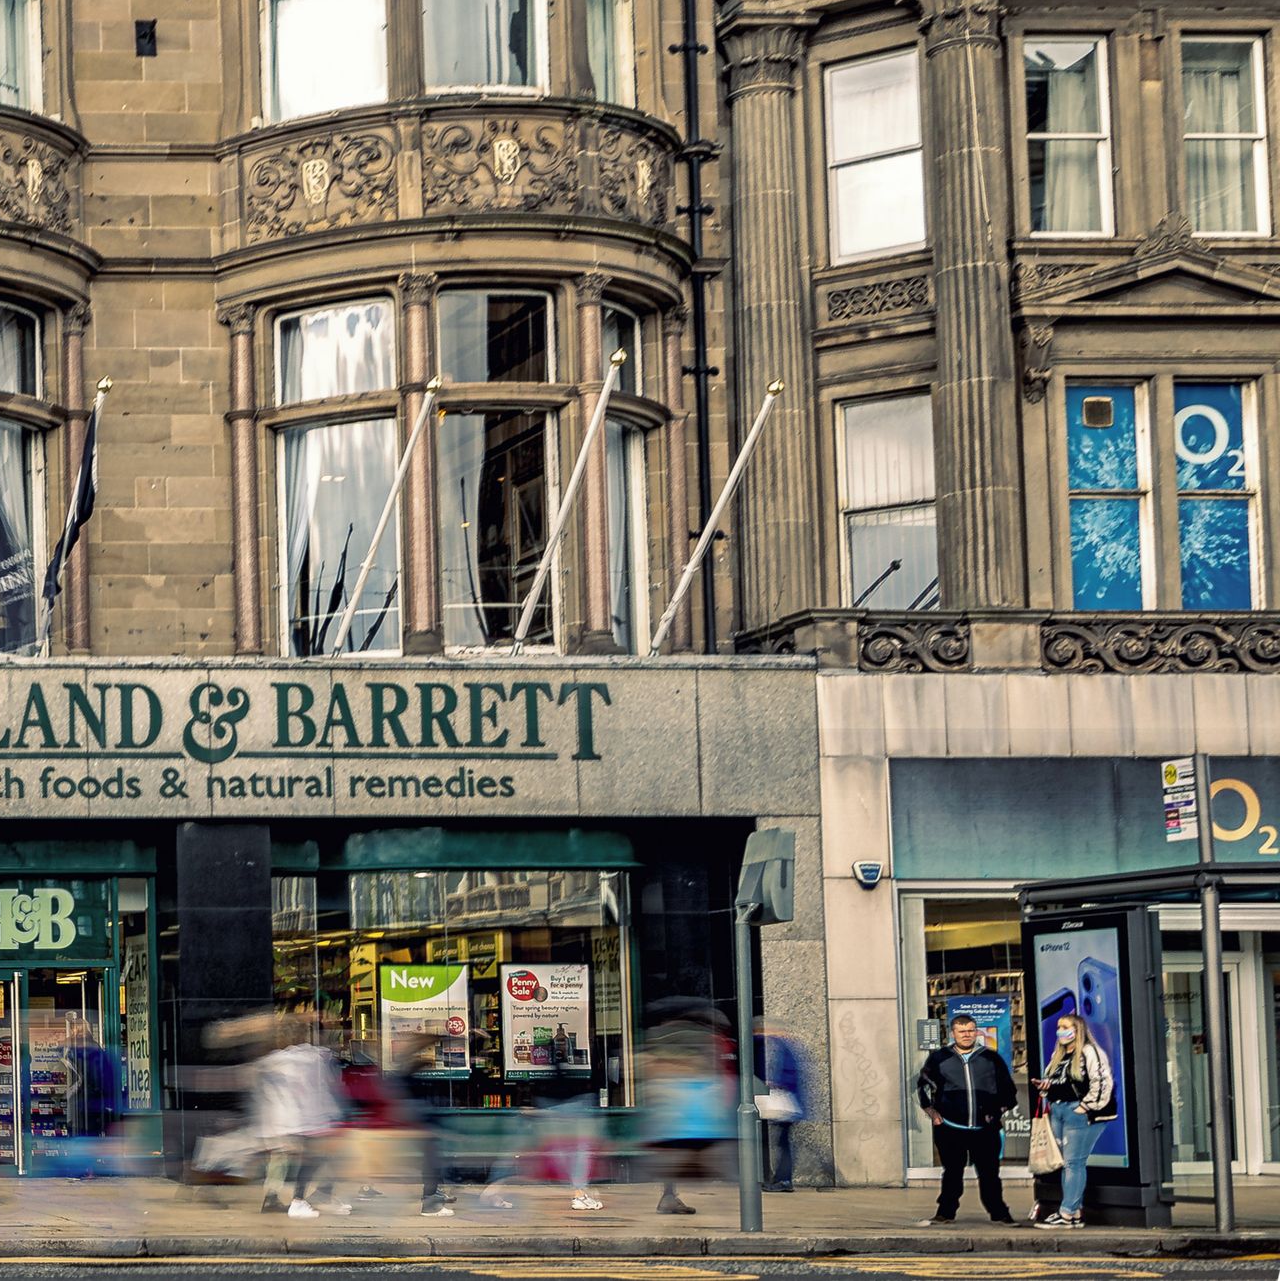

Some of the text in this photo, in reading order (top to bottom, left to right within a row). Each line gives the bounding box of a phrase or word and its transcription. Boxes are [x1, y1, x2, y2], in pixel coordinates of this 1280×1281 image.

[181, 682, 250, 764] &
[270, 681, 613, 761] BARRETT
[40, 766, 142, 800] foods
[159, 768, 190, 800] &
[207, 766, 334, 800] natural
[349, 766, 516, 800] remedies
[1208, 778, 1279, 855] O2
[390, 969, 435, 989] New
[511, 977, 538, 989] Penny
[550, 975, 561, 983] Buy
[511, 986, 530, 995] Sale
[525, 1004, 541, 1013] spring
[541, 1004, 560, 1012] beauty
